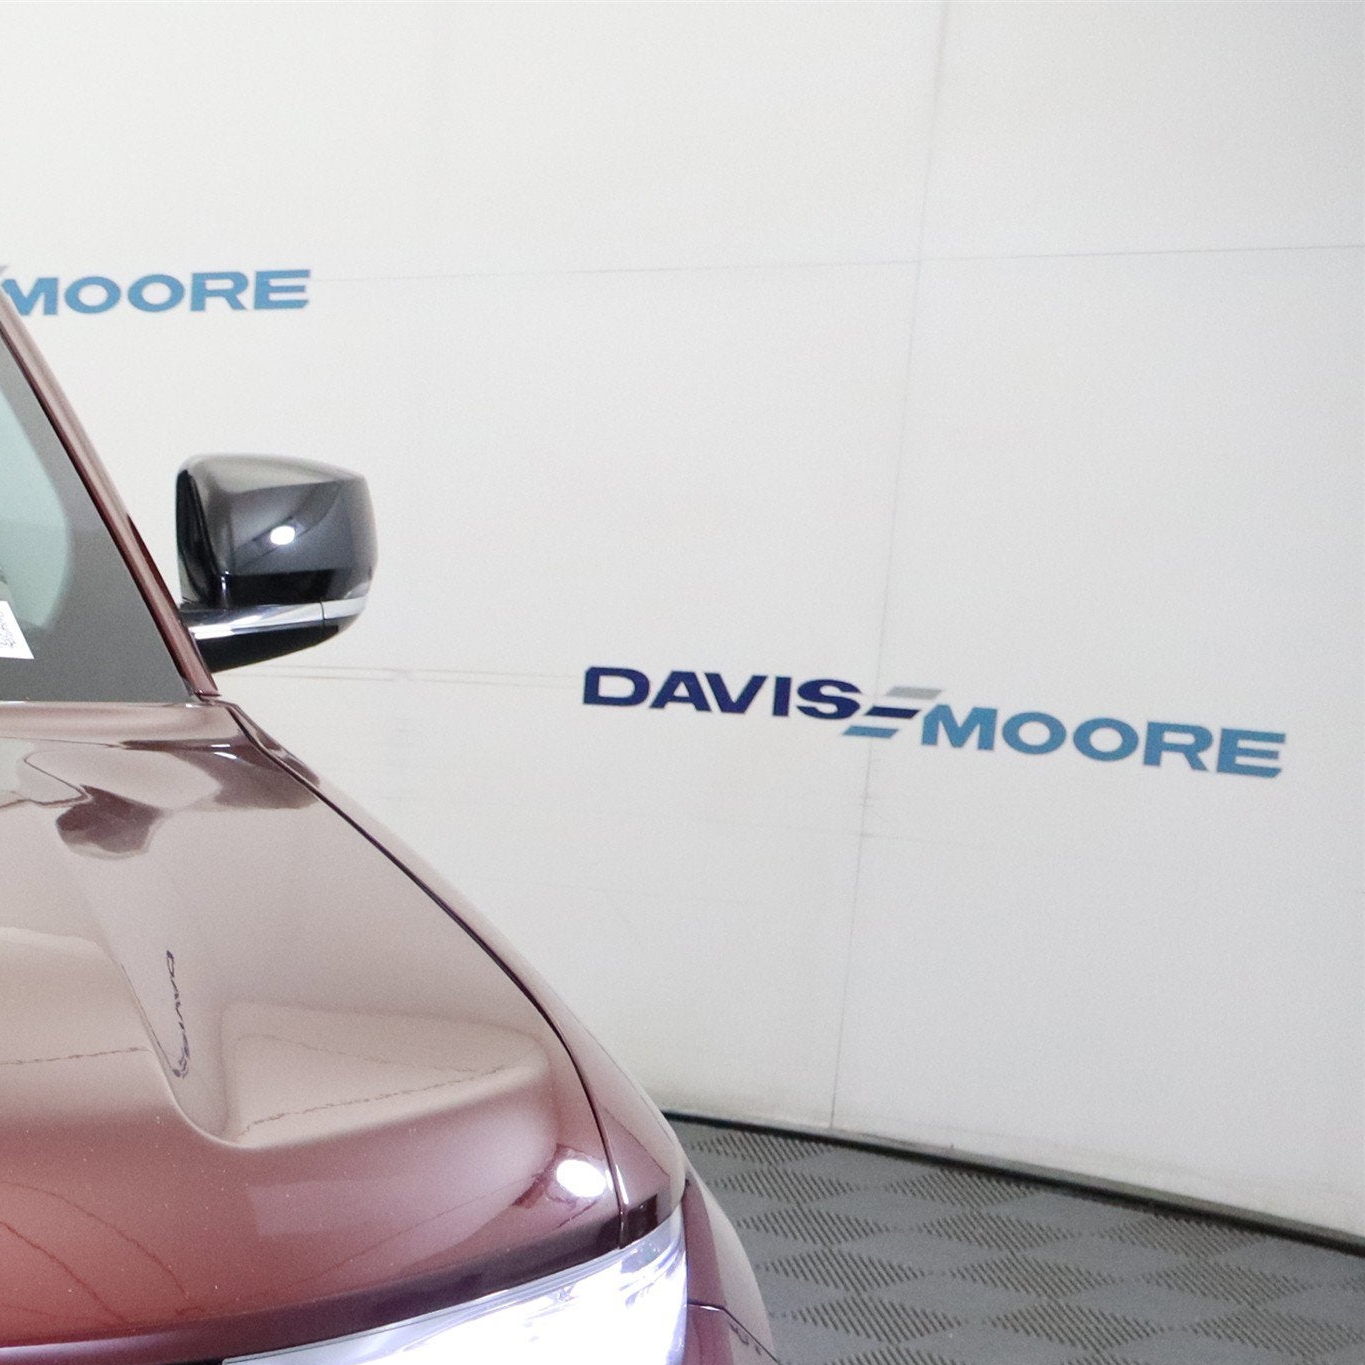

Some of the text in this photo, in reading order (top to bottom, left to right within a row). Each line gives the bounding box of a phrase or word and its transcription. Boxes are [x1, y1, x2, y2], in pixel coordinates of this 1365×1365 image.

[1, 269, 311, 317] MOORE
[582, 665, 1287, 779] DAVIS MOORE
